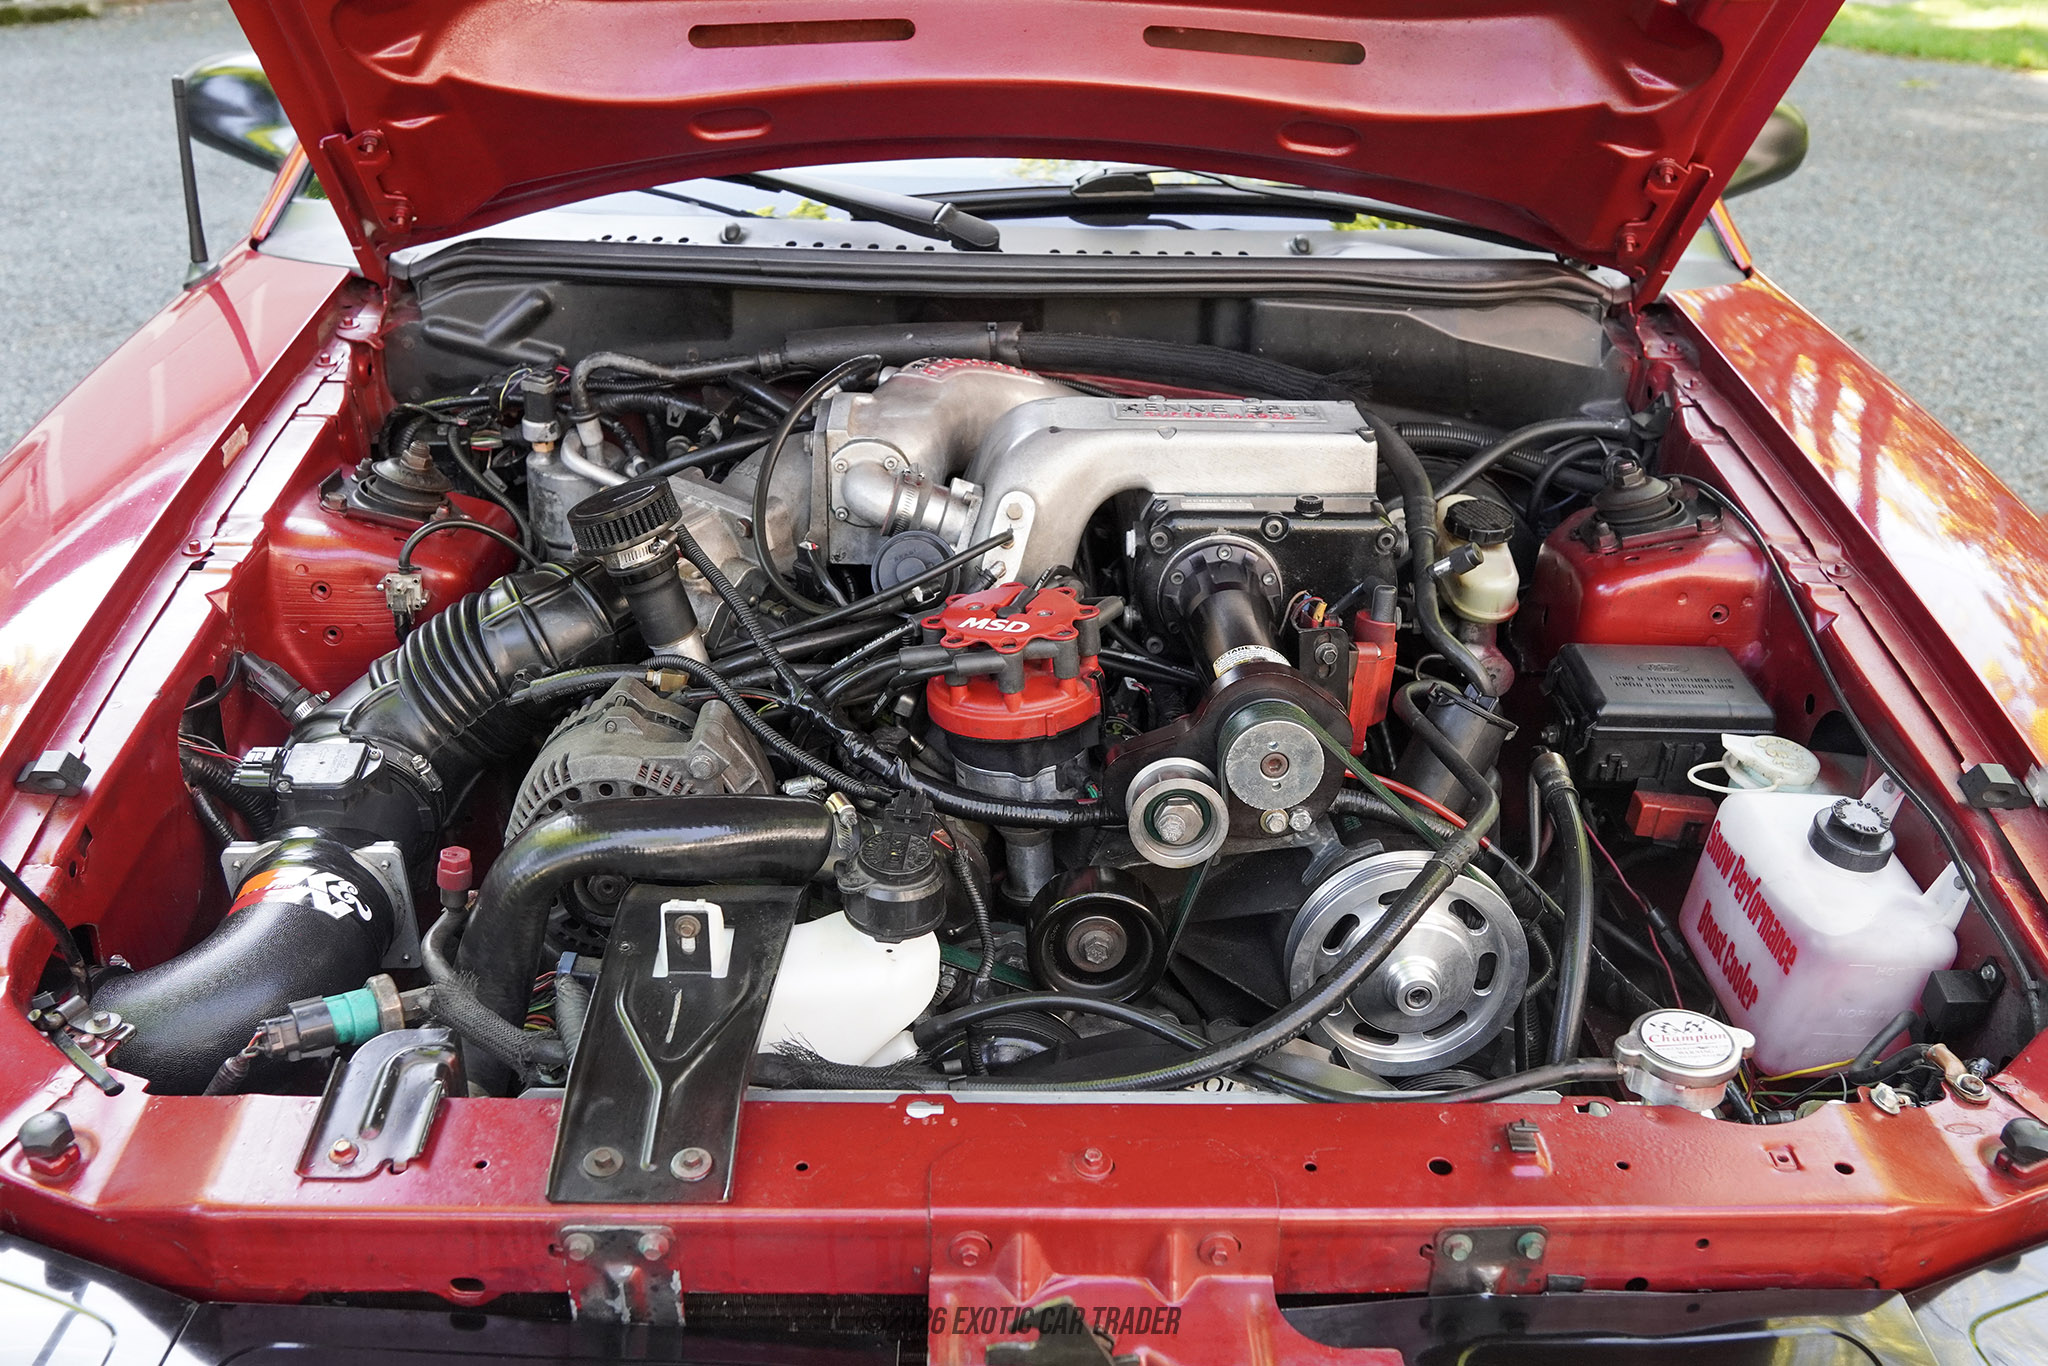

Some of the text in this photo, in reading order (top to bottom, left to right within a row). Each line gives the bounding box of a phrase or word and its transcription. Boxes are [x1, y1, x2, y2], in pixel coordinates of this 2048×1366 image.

[957, 617, 1031, 633] MSD
[1706, 819, 1798, 976] Snow Performance
[1697, 899, 1759, 1012] Boost Cooler
[1648, 1031, 1728, 1043] Champion
